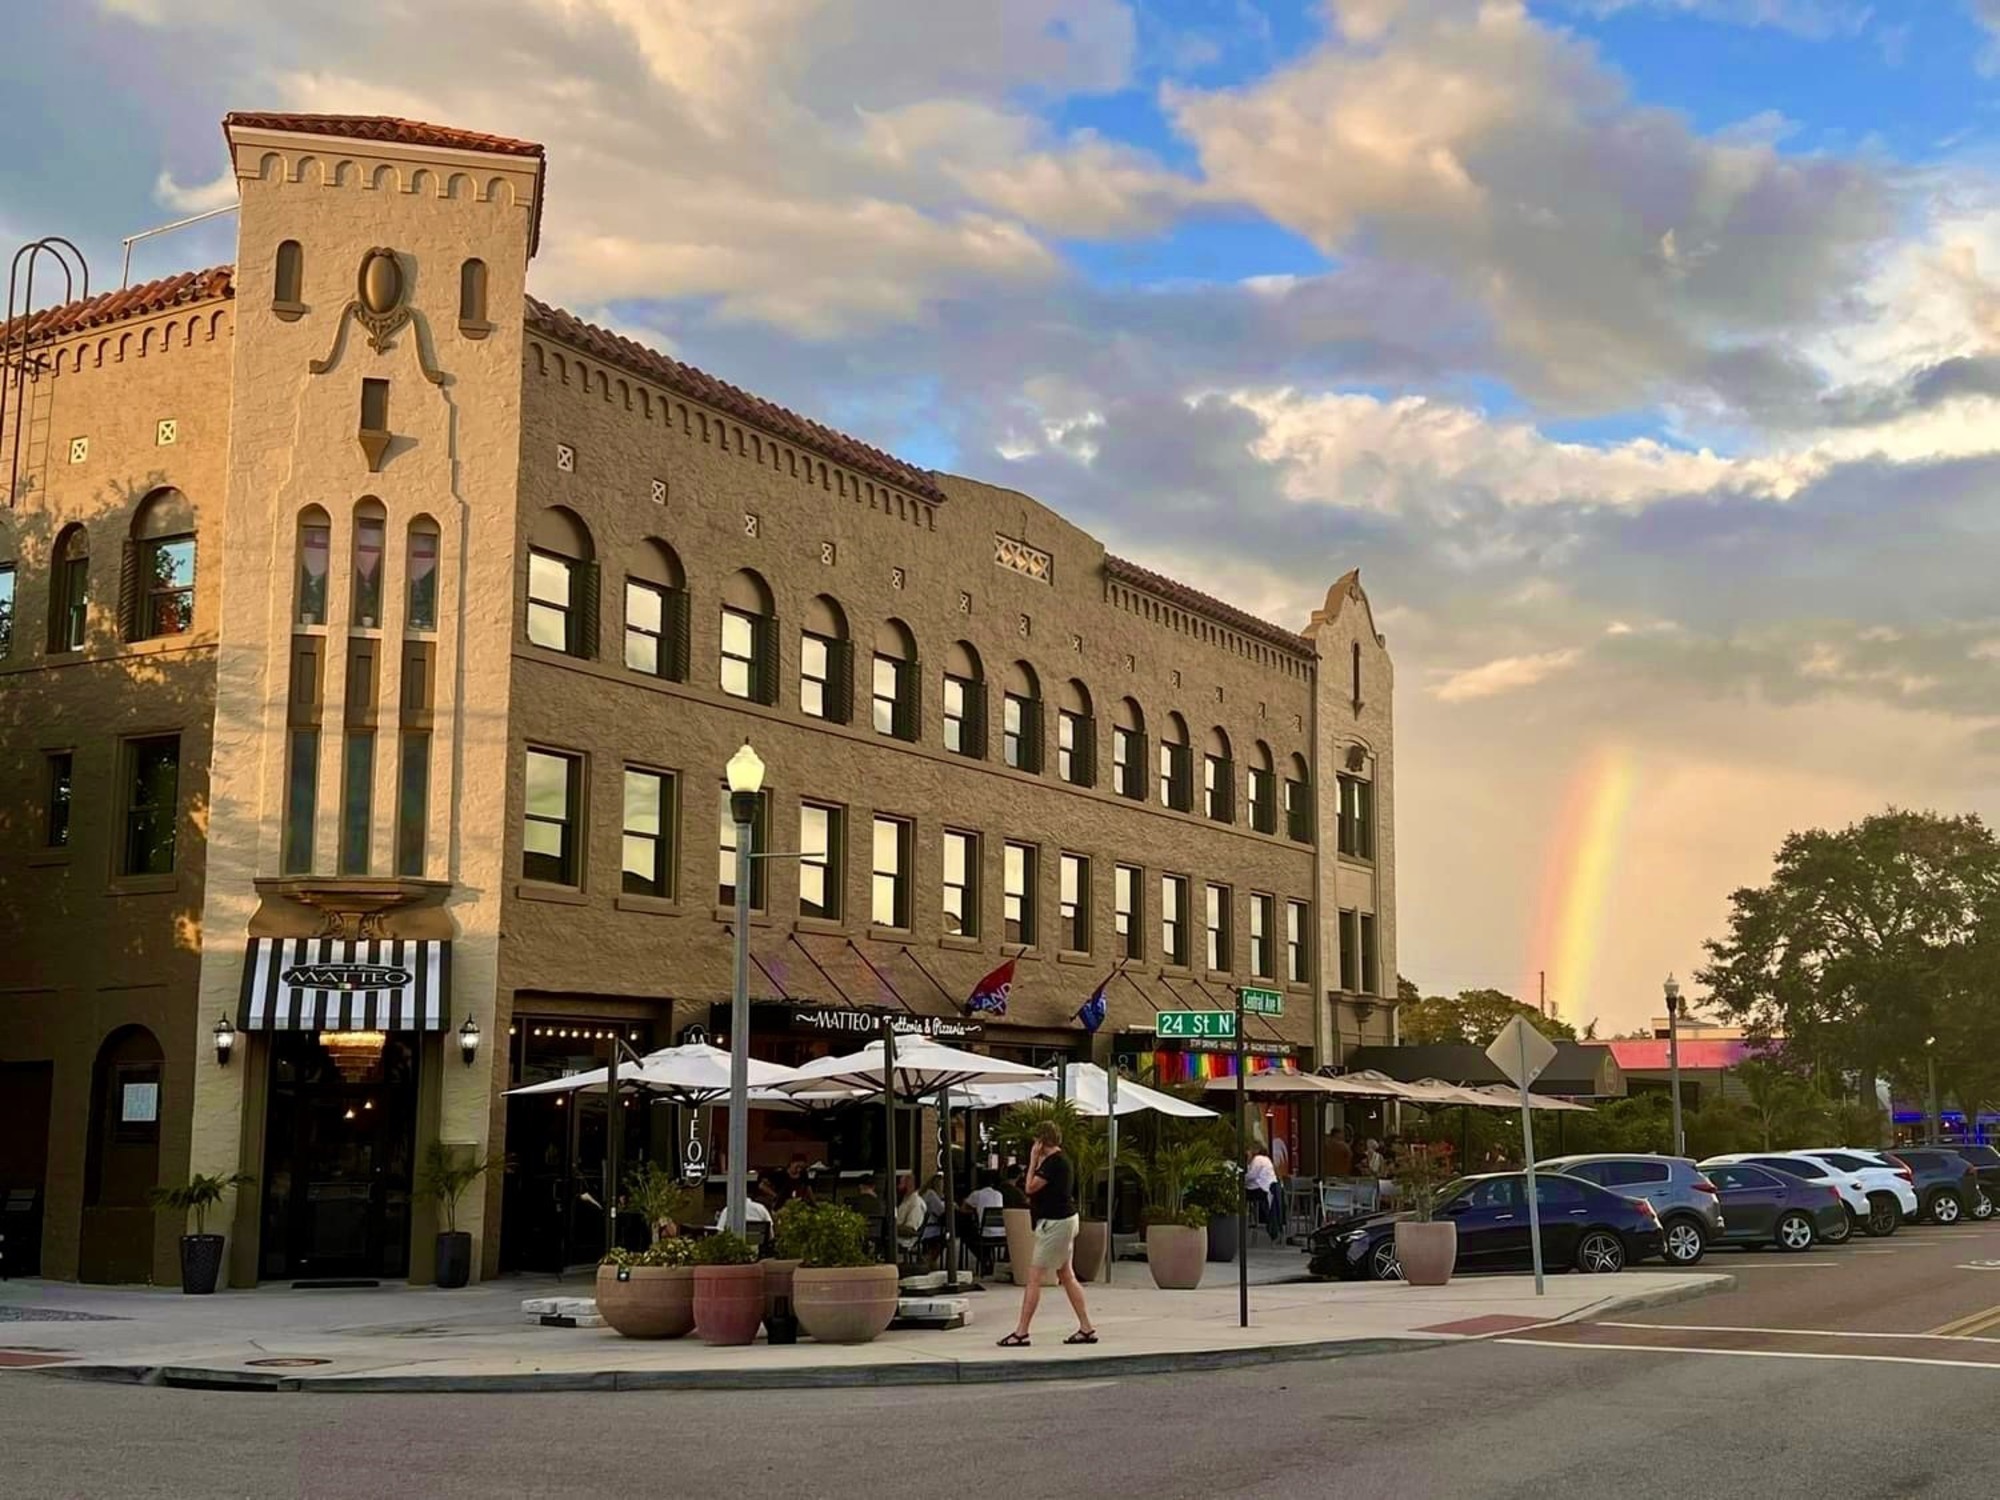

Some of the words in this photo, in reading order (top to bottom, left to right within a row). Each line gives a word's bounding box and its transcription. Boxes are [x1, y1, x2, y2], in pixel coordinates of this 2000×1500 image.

[288, 971, 407, 984] MATTEO
[1243, 990, 1264, 1011] Central
[1265, 993, 1276, 1013] Ave
[815, 1011, 871, 1032] MATTEO
[924, 1017, 931, 1034] &
[932, 1017, 965, 1036] Pizzeria
[1162, 1015, 1183, 1033] 24
[1193, 1015, 1209, 1033] St
[1220, 1015, 1230, 1033] N
